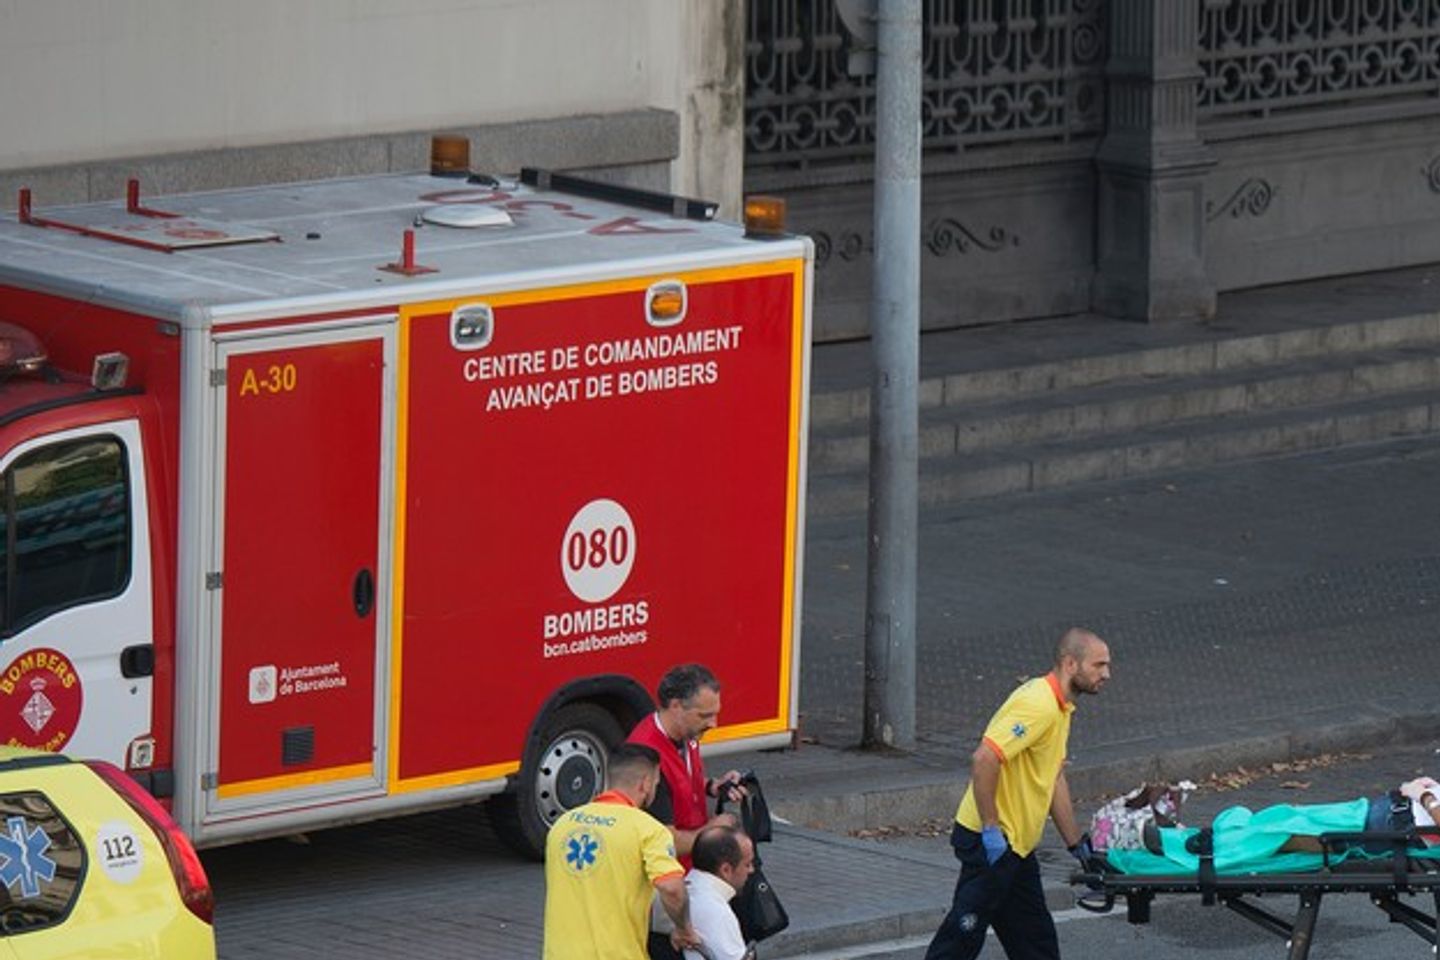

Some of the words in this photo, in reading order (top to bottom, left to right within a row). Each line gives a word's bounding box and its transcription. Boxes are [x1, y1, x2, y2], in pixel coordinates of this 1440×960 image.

[463, 350, 546, 382] CENTRE
[551, 346, 580, 371] DE
[584, 326, 743, 366] COMANDAMENT
[239, 364, 297, 397] A-30
[485, 378, 580, 412] AVANÇAT
[585, 375, 613, 400] DE
[617, 361, 719, 395] BOMBERS
[567, 525, 629, 572] 080
[543, 601, 649, 639] BOMBERS
[1, 651, 77, 695] BOMBERS
[103, 835, 137, 861] 112
